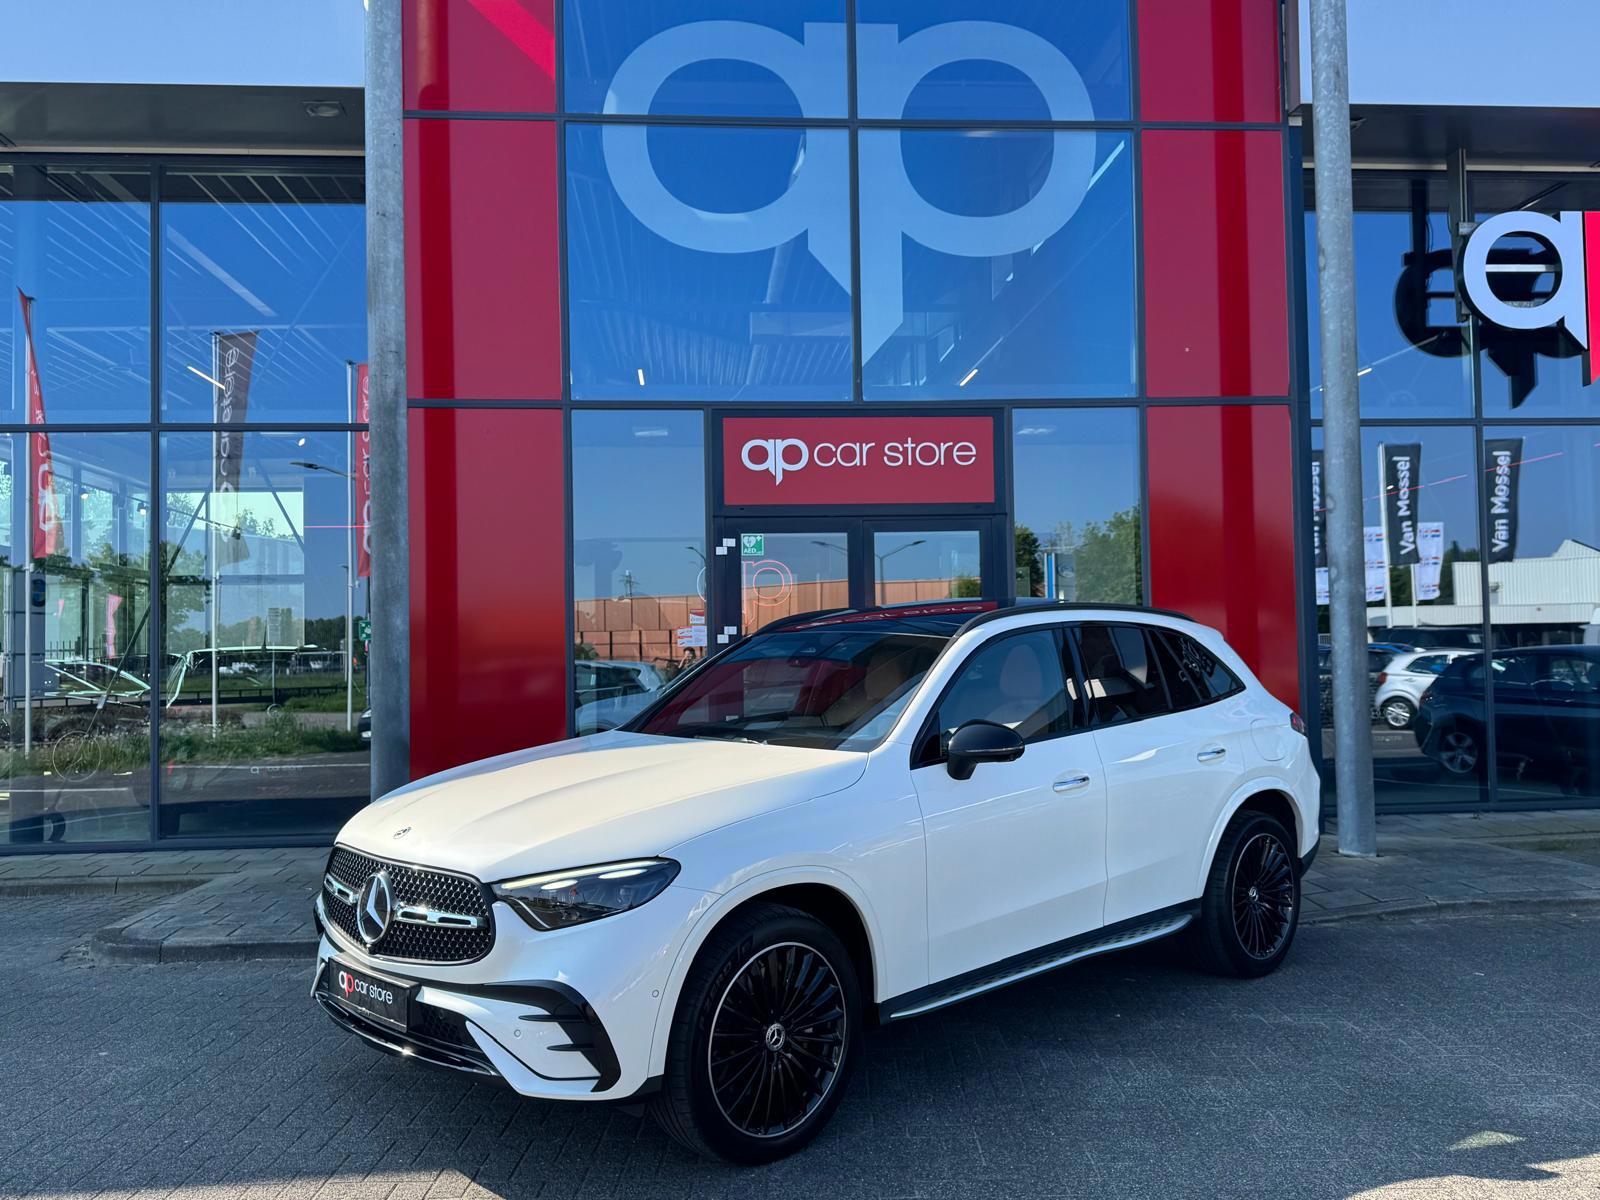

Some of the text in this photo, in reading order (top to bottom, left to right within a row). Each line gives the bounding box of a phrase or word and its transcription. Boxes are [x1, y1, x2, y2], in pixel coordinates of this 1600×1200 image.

[602, 20, 1096, 368] ap
[1463, 210, 1600, 386] a
[741, 437, 977, 486] ap car store
[1391, 455, 1416, 555] Van Mossel
[1490, 450, 1512, 553] Van Mossel
[338, 970, 393, 1004] ap car store
